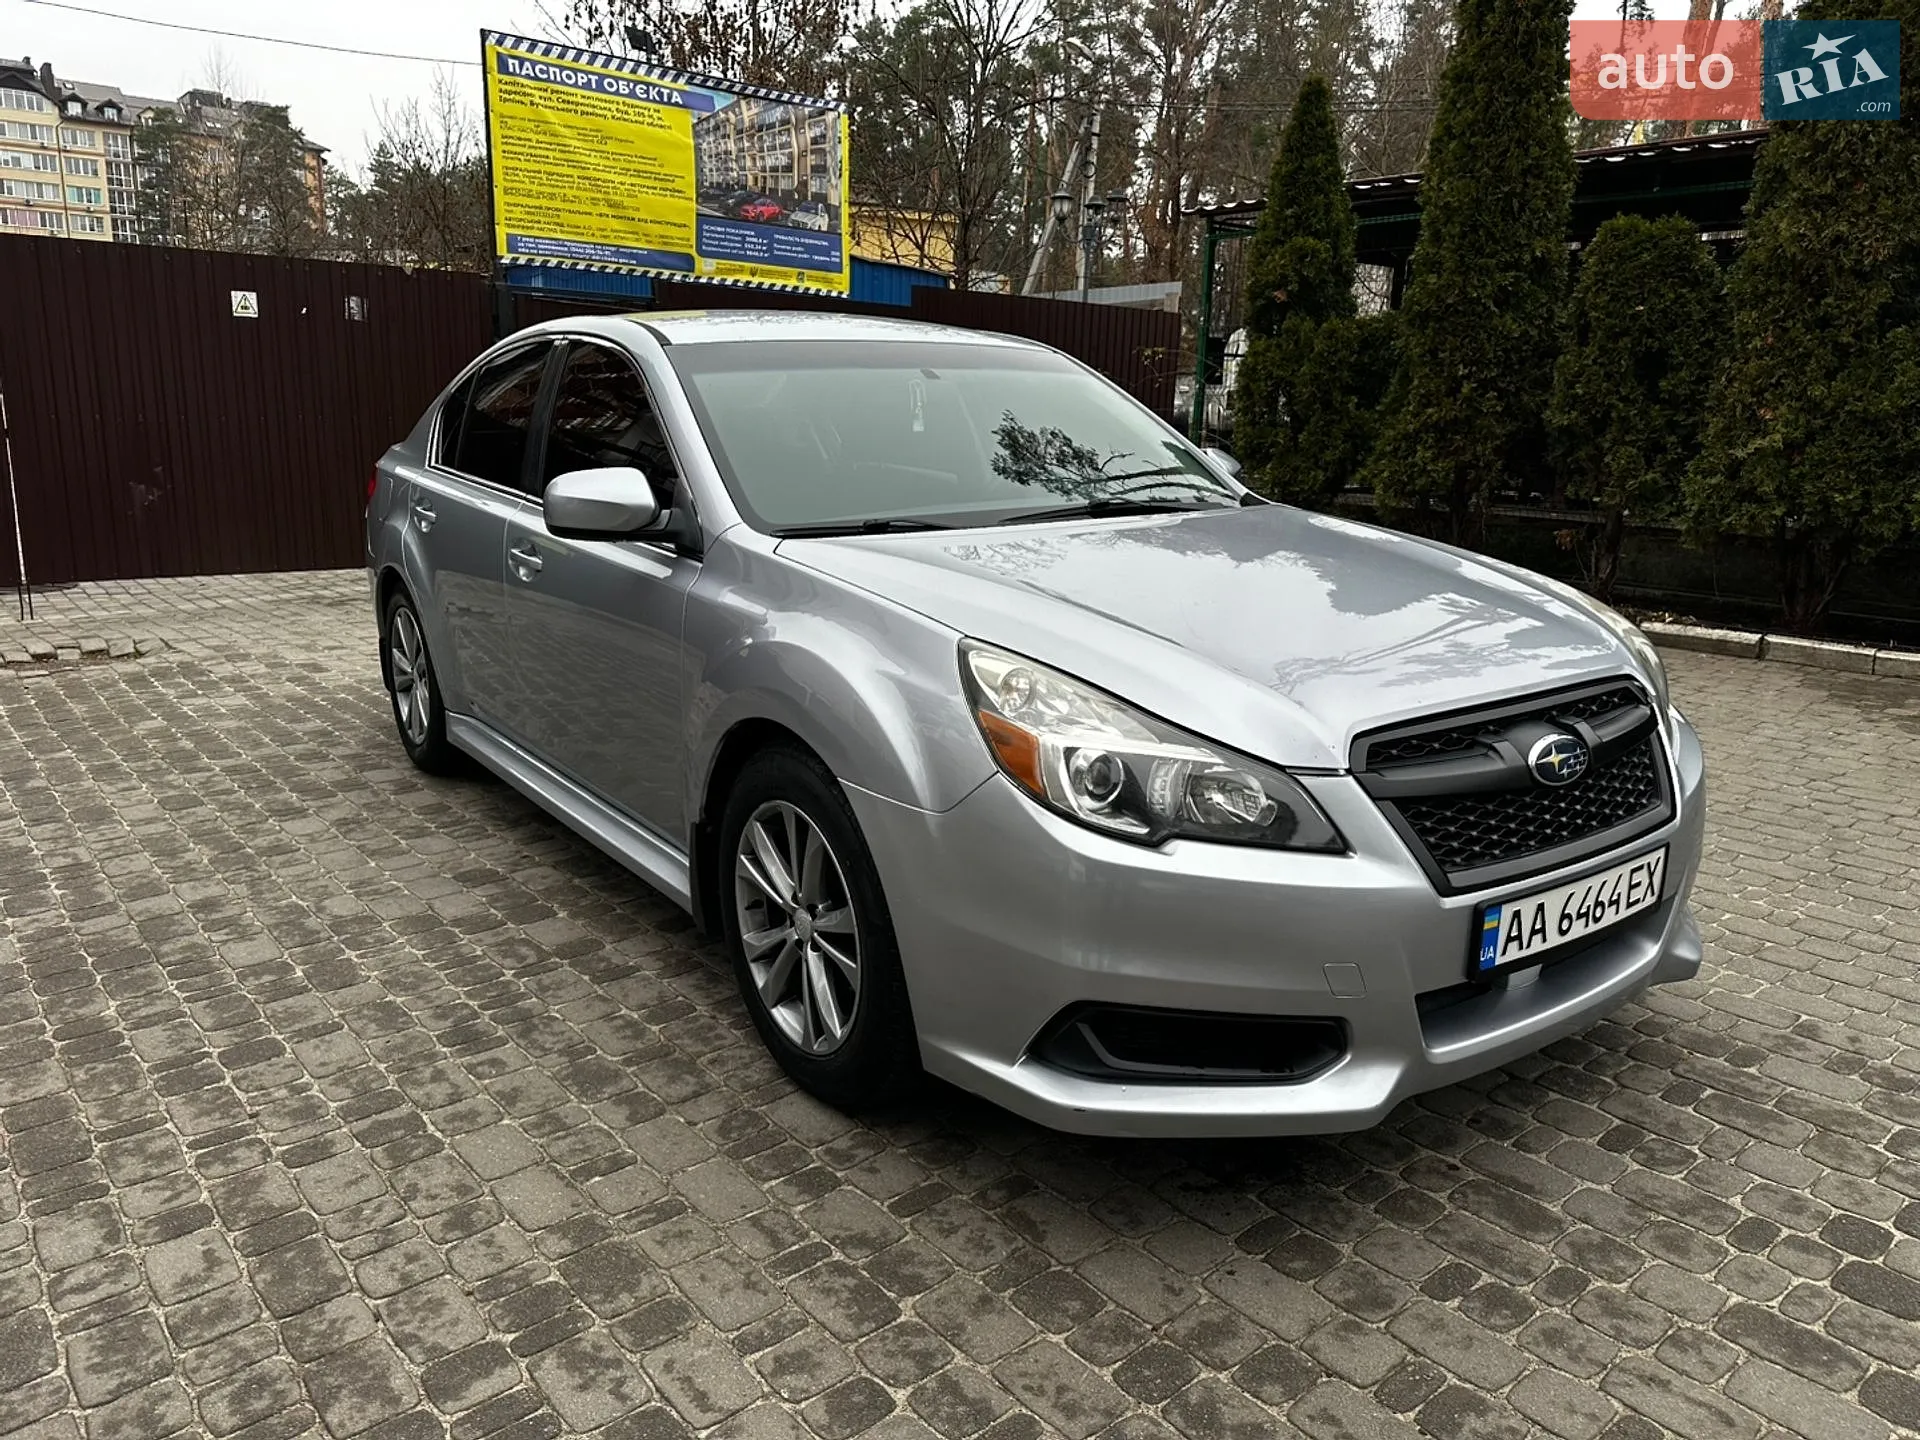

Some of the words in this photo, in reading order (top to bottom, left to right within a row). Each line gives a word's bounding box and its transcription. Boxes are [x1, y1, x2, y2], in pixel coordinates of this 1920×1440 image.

[497, 76, 549, 93] Капітальний
[550, 87, 577, 99] ремонт
[508, 59, 599, 90] ПАСПОРТ
[603, 78, 682, 106] ОБ'ЄКТА
[1501, 902, 1547, 956] AA
[1558, 873, 1623, 937] 6464
[1626, 856, 1661, 910] EX
[1480, 944, 1495, 961] UA
